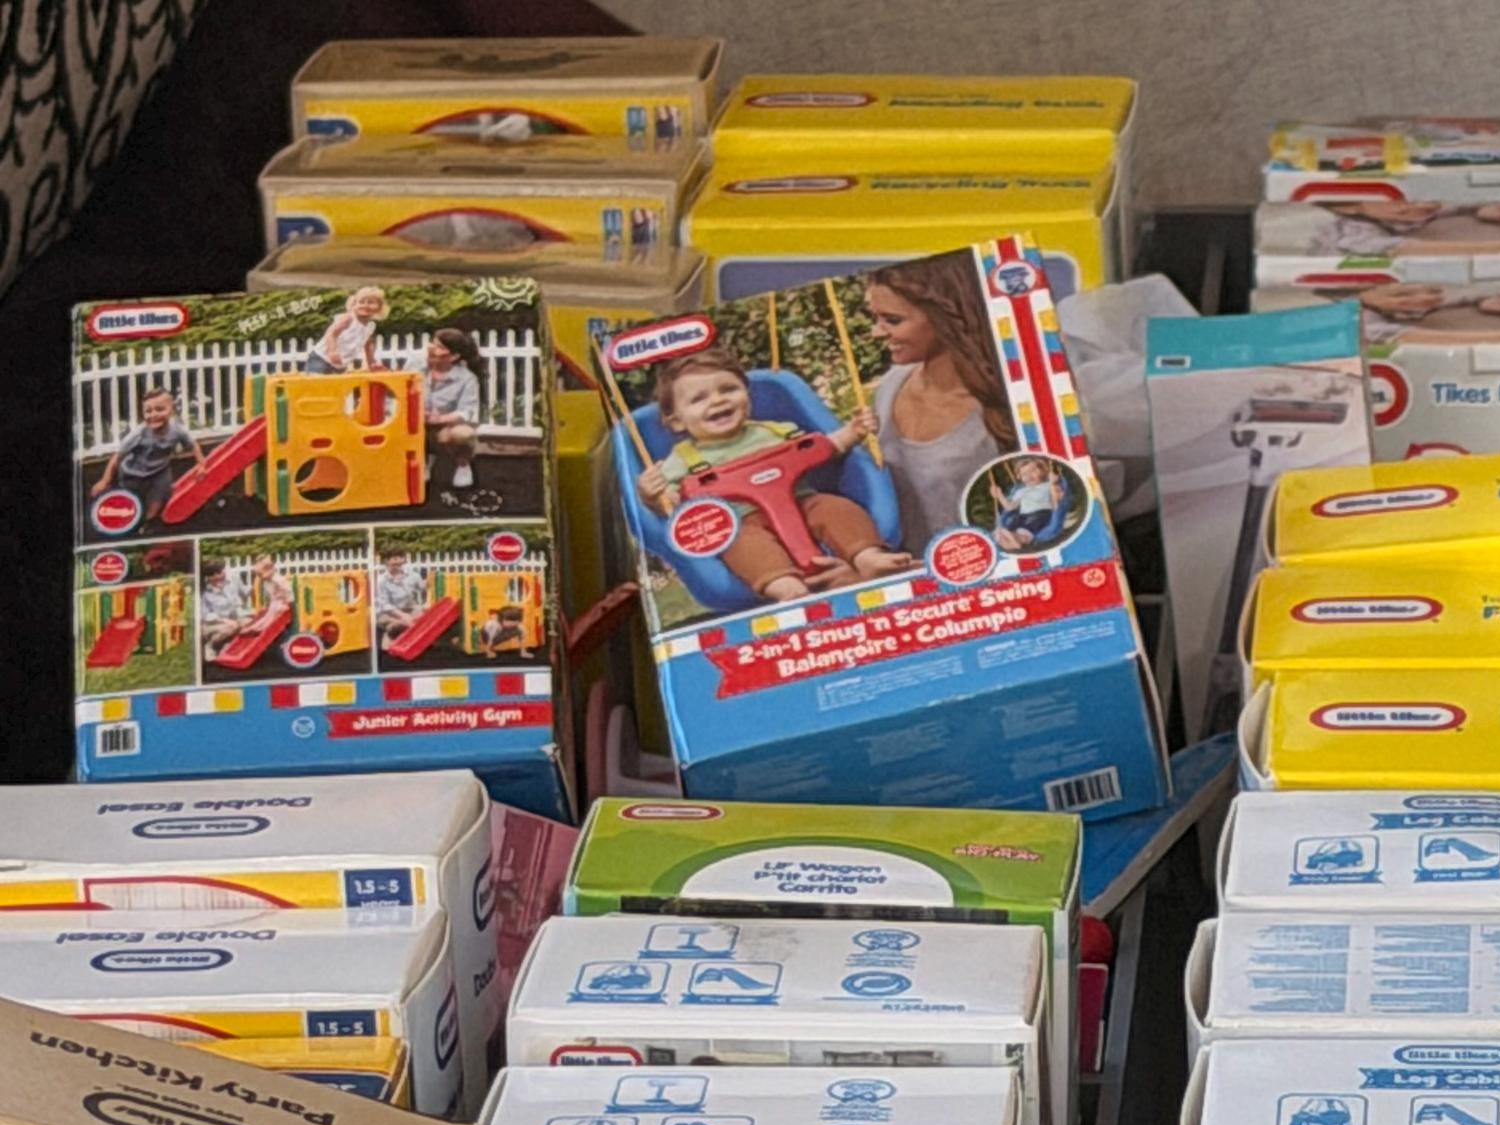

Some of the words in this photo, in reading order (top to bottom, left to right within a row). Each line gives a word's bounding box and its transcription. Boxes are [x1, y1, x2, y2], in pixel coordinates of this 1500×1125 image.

[99, 313, 135, 328] little
[139, 312, 178, 325] tikes
[617, 338, 658, 359] little
[660, 325, 704, 350] tikes
[1431, 383, 1492, 403] Tikes
[738, 633, 802, 665] 2-in-1
[805, 623, 867, 648] Snug
[893, 595, 974, 627] Secure
[978, 578, 1053, 608] Swing
[778, 635, 898, 679] Balançoire
[916, 604, 1027, 644] Columpio
[353, 713, 408, 731] Junior
[413, 708, 478, 730] Activity
[483, 706, 522, 722] Gym
[97, 801, 184, 815] Easel
[194, 797, 312, 811] Double
[1403, 814, 1444, 829] Log
[800, 861, 882, 875] Wagon
[807, 873, 887, 884] chariot
[777, 882, 858, 895] Carrito
[55, 931, 145, 943] Easel
[155, 929, 276, 942] Double
[30, 1031, 207, 1092] Kitchen
[1393, 1072, 1437, 1089] Log
